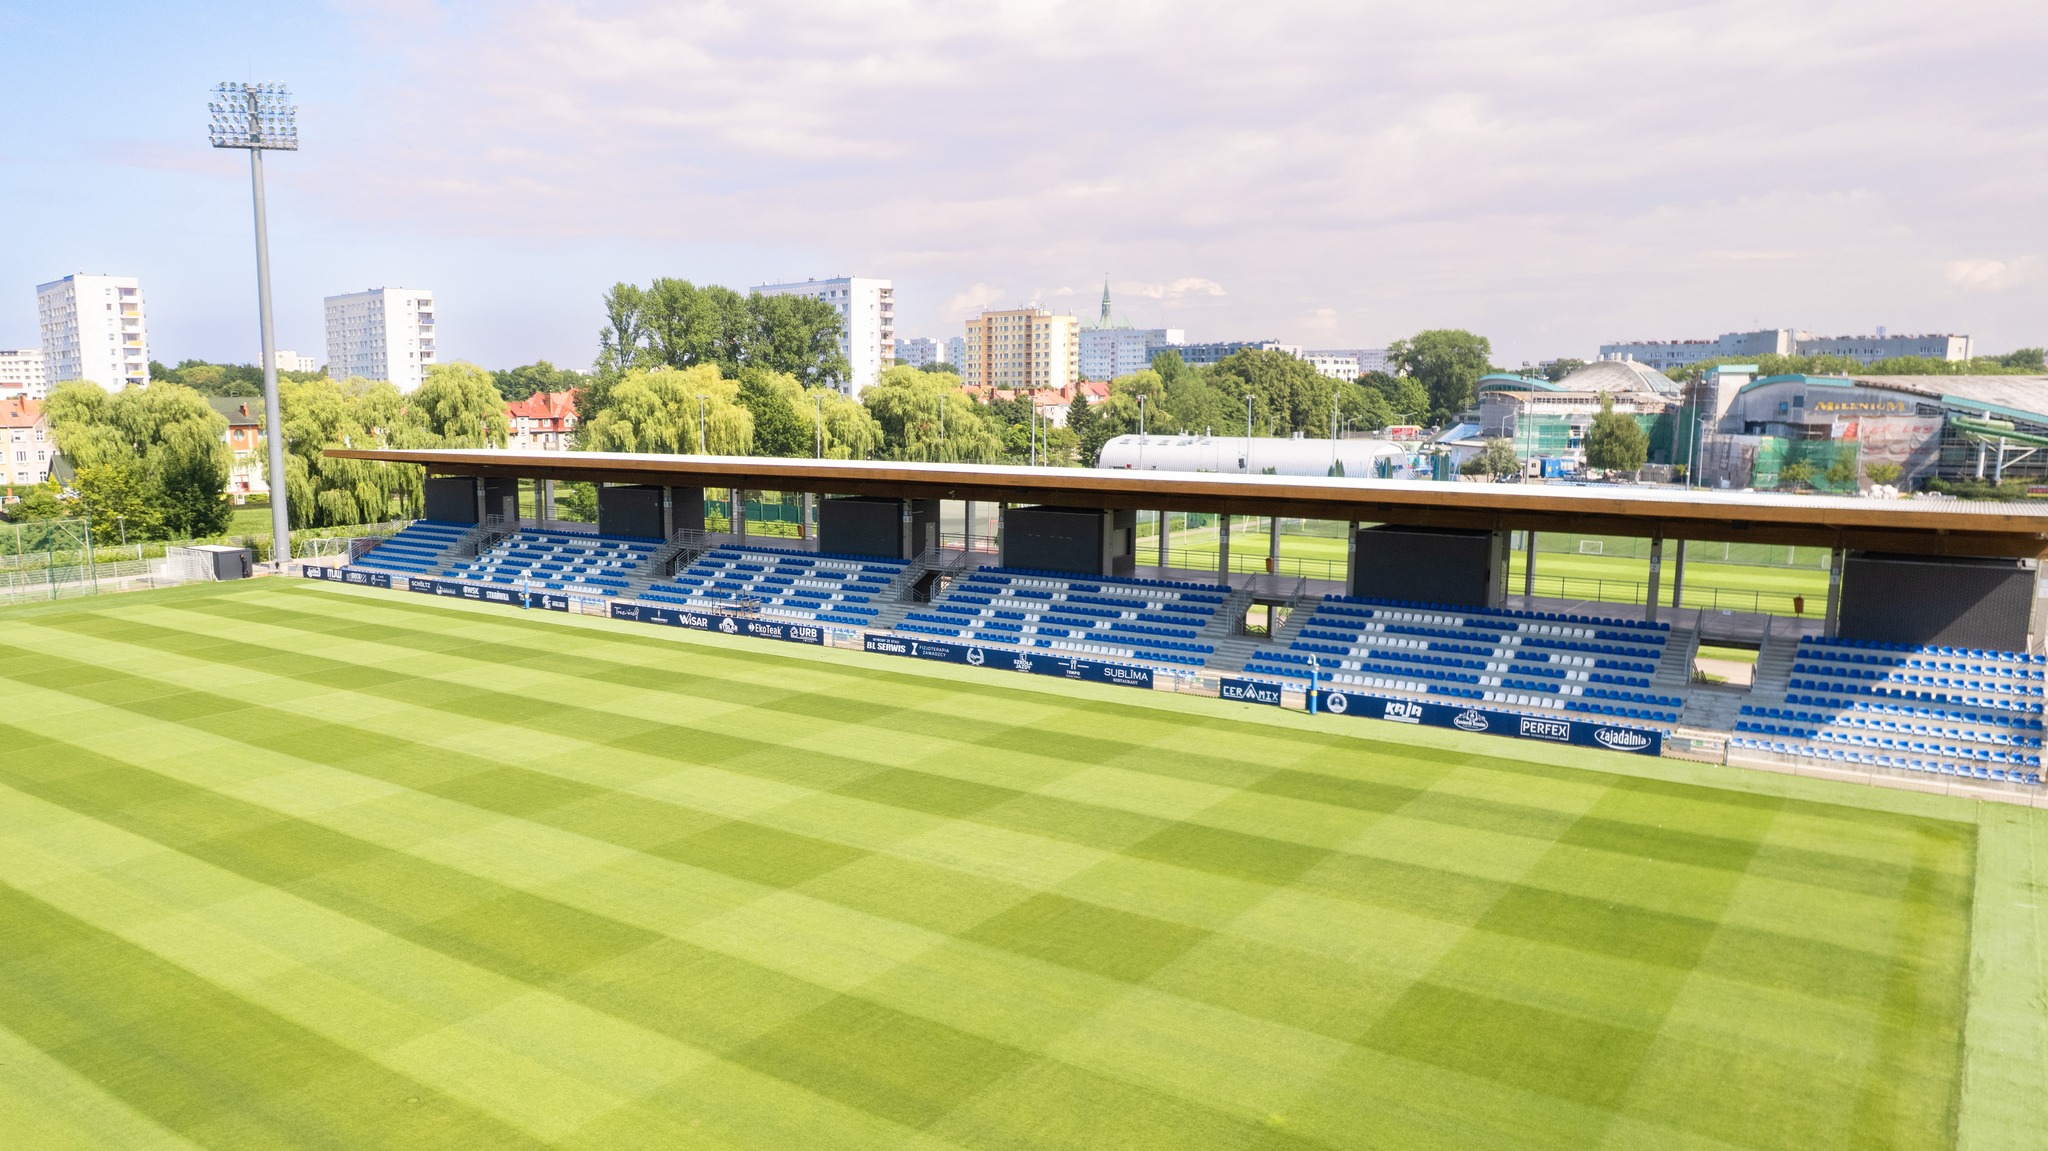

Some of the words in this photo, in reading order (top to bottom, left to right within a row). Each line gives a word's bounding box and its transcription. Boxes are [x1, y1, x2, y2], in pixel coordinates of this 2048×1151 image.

[756, 623, 782, 636] EkoTeak
[799, 627, 817, 638] URB
[866, 641, 876, 650] BL
[877, 642, 906, 653] SERWIS
[1523, 721, 1567, 737] PERFEX
